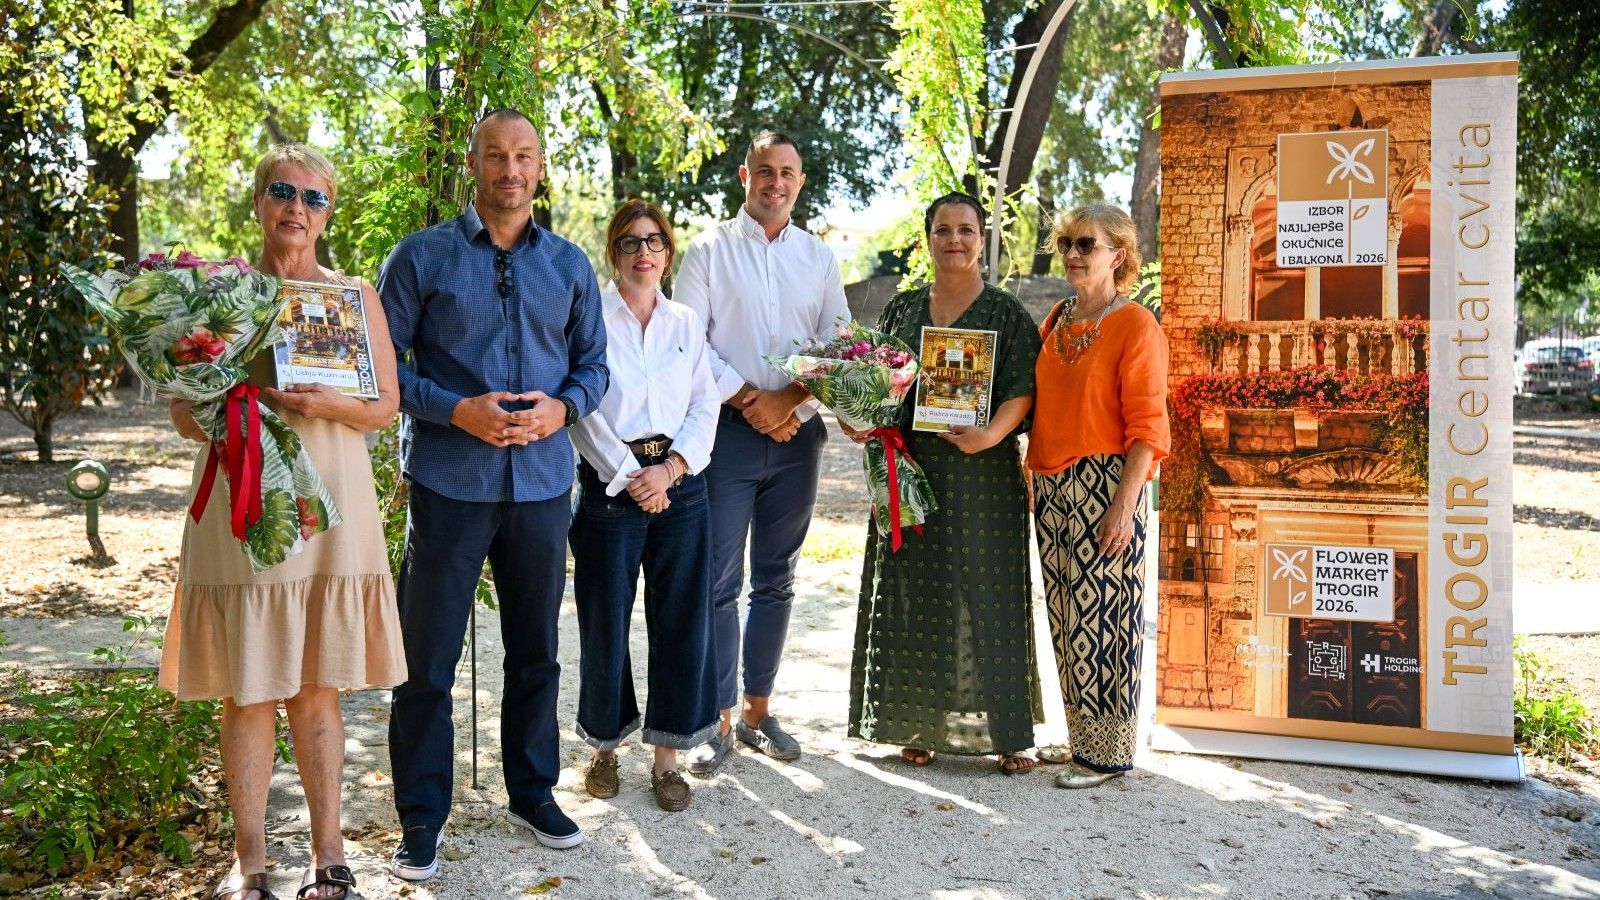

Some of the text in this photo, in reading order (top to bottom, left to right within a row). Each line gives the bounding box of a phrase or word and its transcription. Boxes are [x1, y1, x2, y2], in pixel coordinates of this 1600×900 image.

[1308, 206, 1344, 216] IZBOR
[1282, 255, 1344, 265] I BALKONA
[1356, 253, 1387, 263] 2026.
[1442, 122, 1491, 686] TROGIR Centar cvita
[1316, 582, 1379, 597] TROGIR
[1316, 599, 1358, 613] 2026.
[1384, 656, 1418, 665] TROGIR
[1384, 664, 1425, 673] HOLDING
